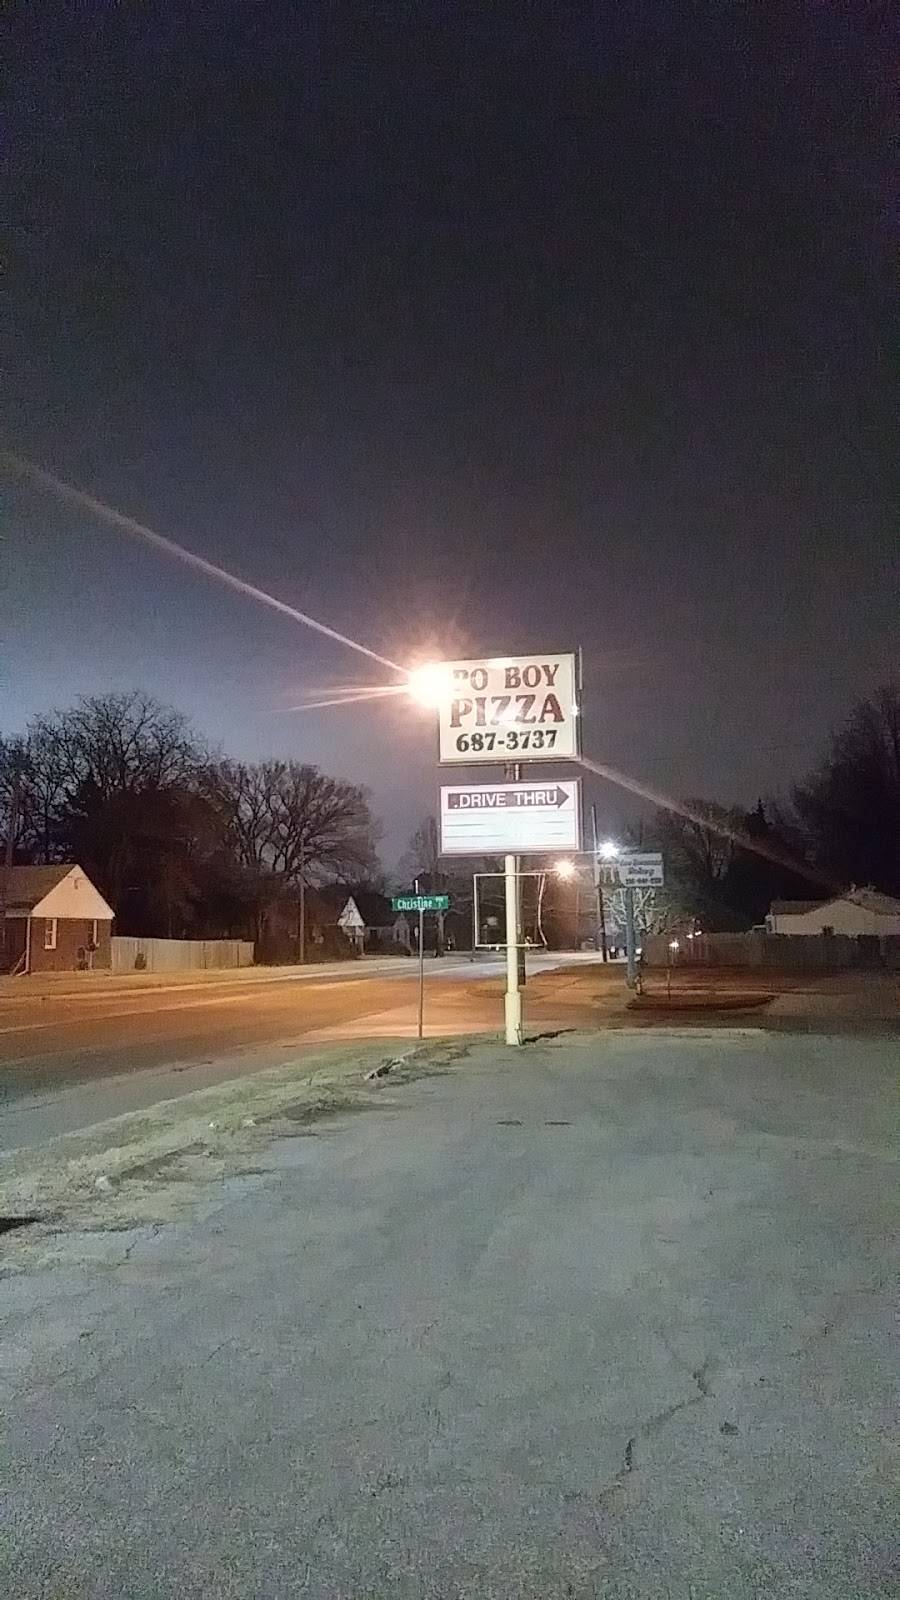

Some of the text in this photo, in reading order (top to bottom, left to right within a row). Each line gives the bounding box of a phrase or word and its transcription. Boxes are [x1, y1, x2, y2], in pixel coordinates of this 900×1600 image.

[504, 664, 560, 689] BOY
[450, 693, 565, 728] PIZZA
[456, 730, 558, 752] 687-3737
[459, 790, 558, 808] DRIVE THRU
[397, 896, 433, 910] Christine
